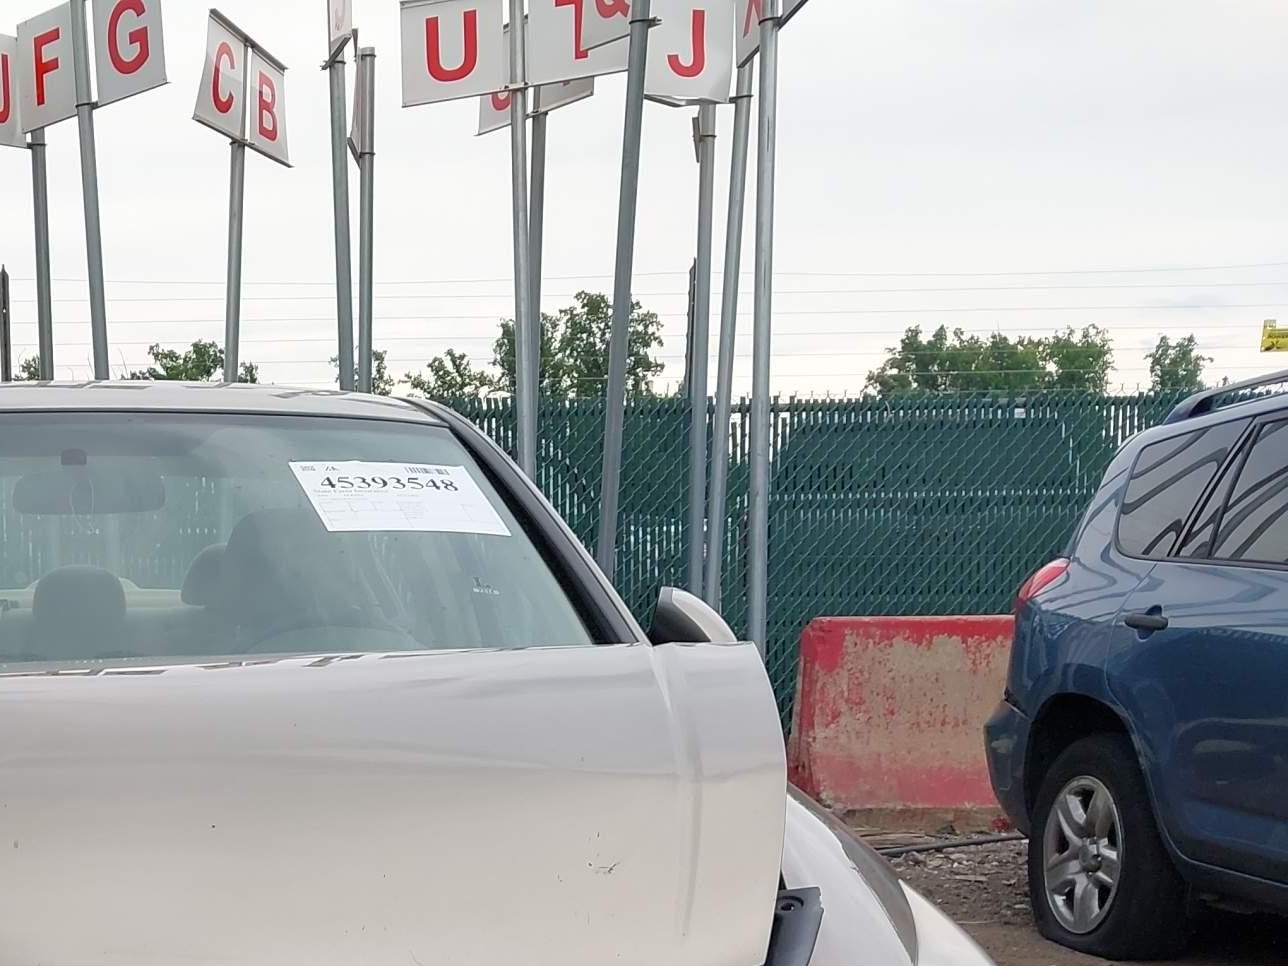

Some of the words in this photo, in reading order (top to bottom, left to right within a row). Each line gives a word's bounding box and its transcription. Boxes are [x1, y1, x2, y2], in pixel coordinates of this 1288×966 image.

[32, 26, 61, 107] F
[107, 0, 150, 75] G
[424, 8, 478, 83] U
[666, 9, 707, 78] J
[212, 40, 236, 114] C
[258, 69, 278, 142] B
[320, 475, 460, 492] 45393548
